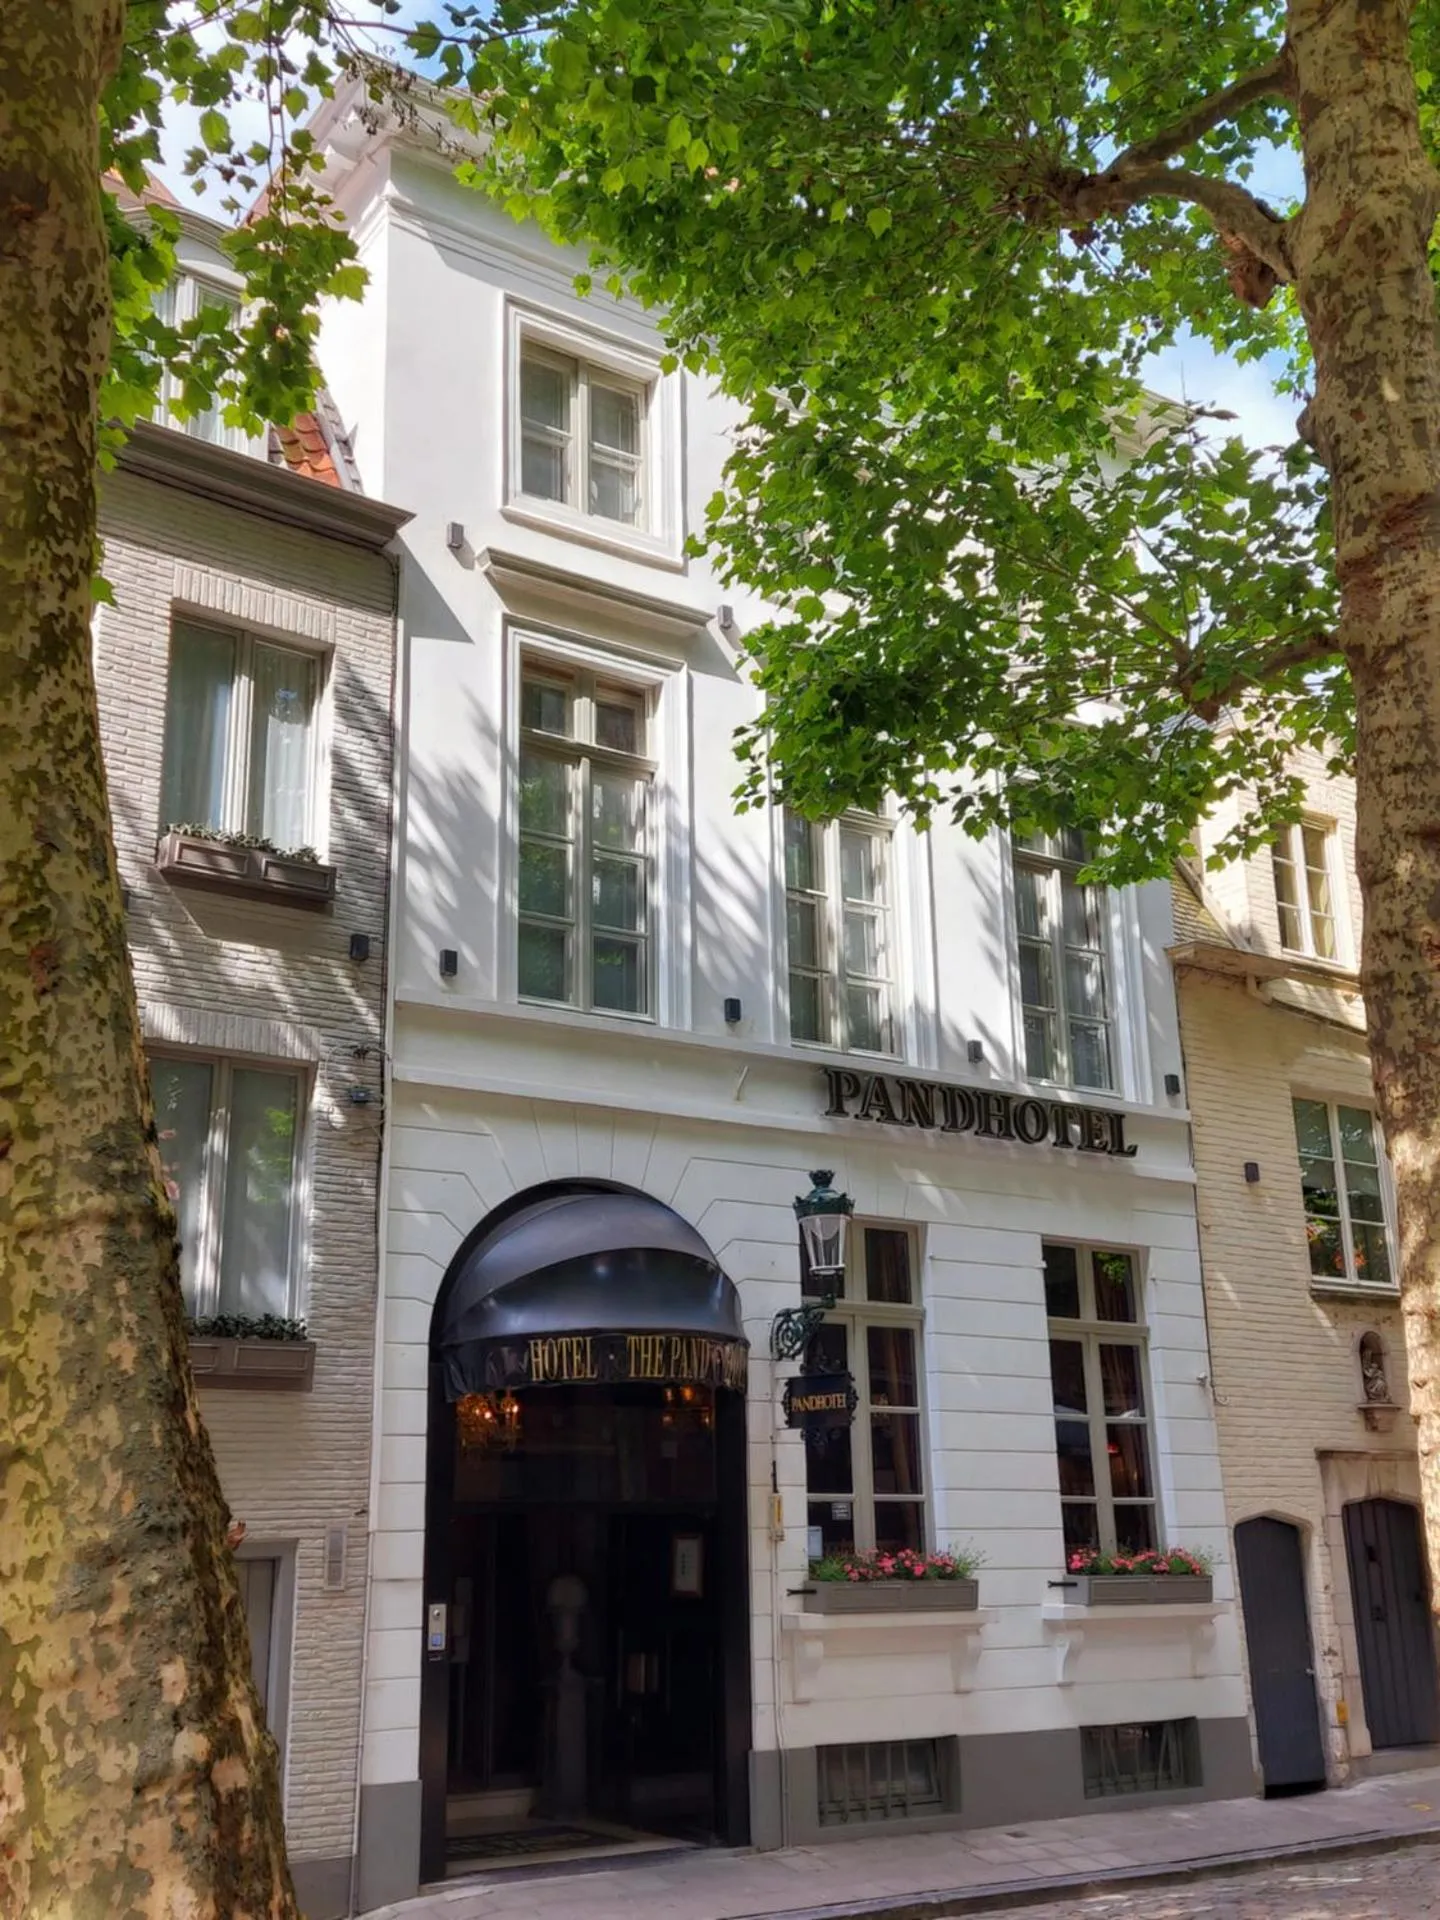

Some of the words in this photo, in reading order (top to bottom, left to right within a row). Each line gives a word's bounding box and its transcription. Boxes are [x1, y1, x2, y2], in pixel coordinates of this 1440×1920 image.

[823, 1066, 1138, 1158] PANDHOTEL
[528, 1335, 598, 1382] HOTEL
[626, 1335, 665, 1378] THE
